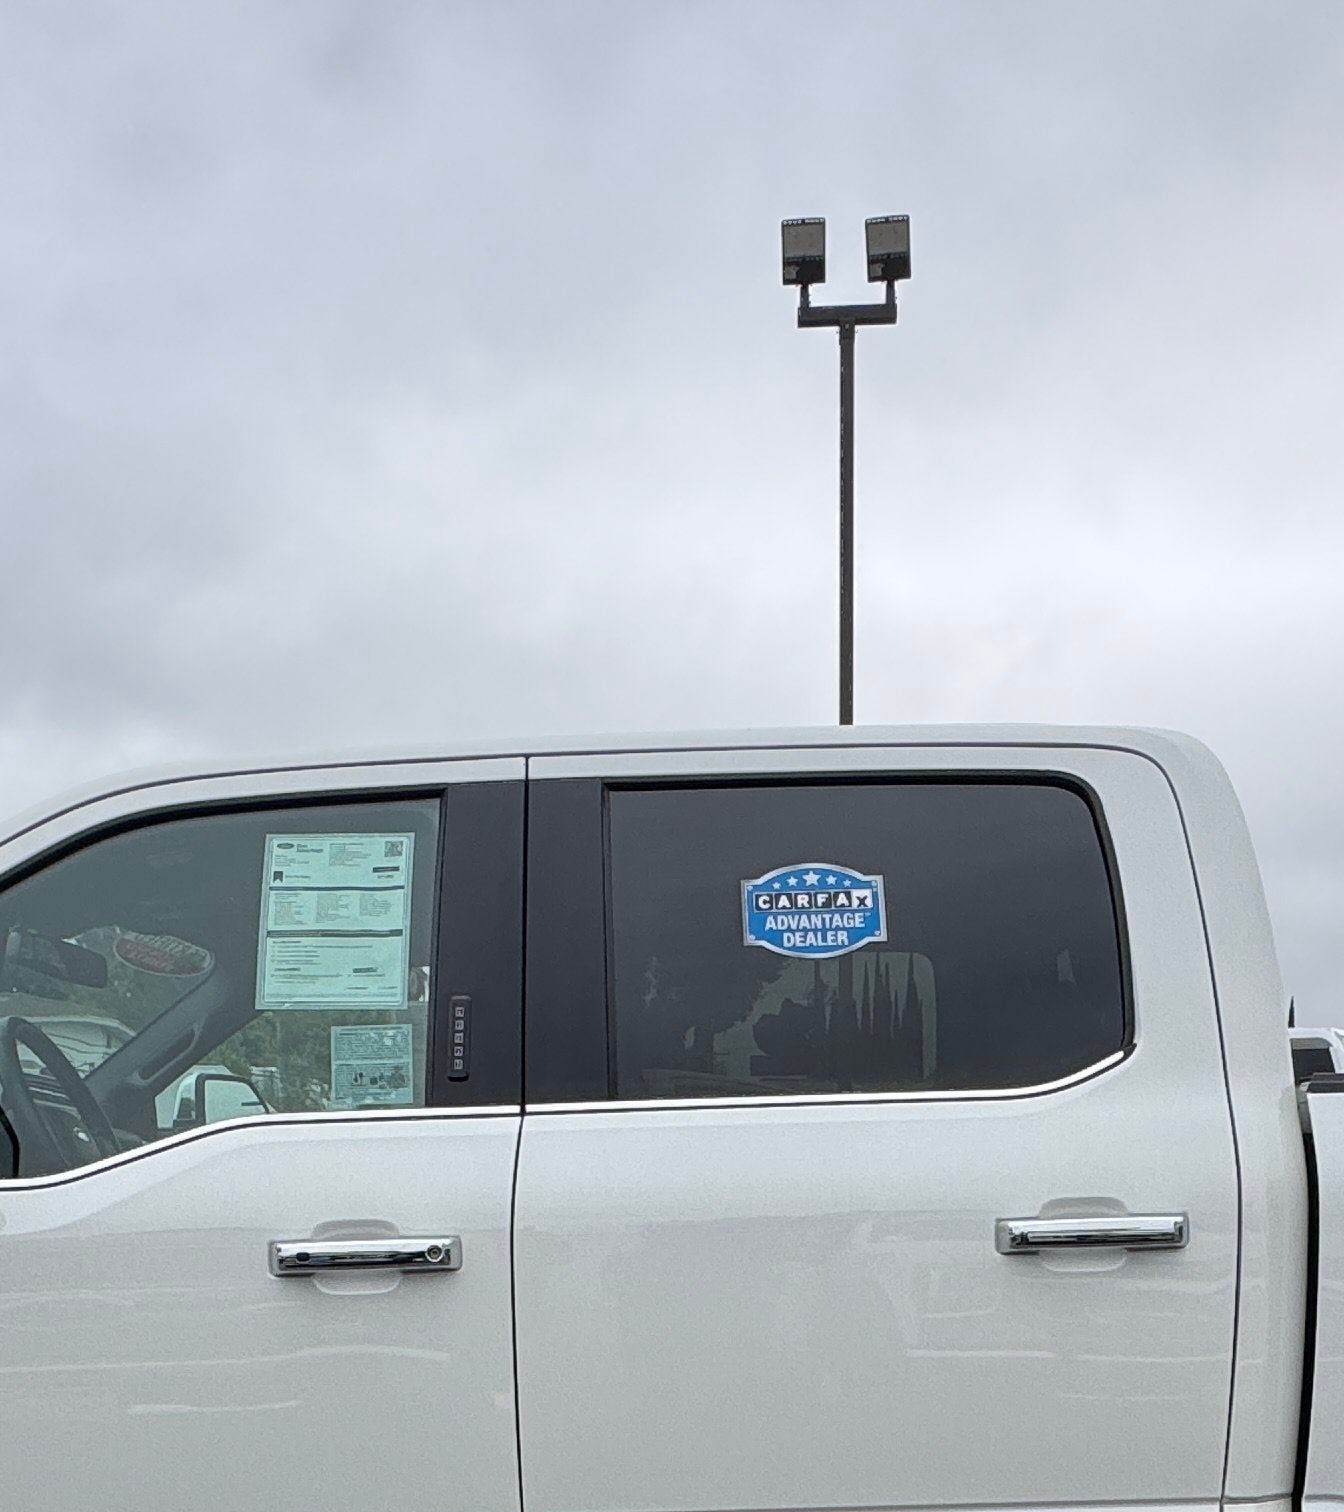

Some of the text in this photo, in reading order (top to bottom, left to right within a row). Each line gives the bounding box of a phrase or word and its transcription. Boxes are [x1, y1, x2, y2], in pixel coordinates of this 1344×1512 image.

[756, 890, 871, 910] CARFAX
[764, 912, 865, 931] ADVANTAGE
[782, 930, 850, 948] DEALER
